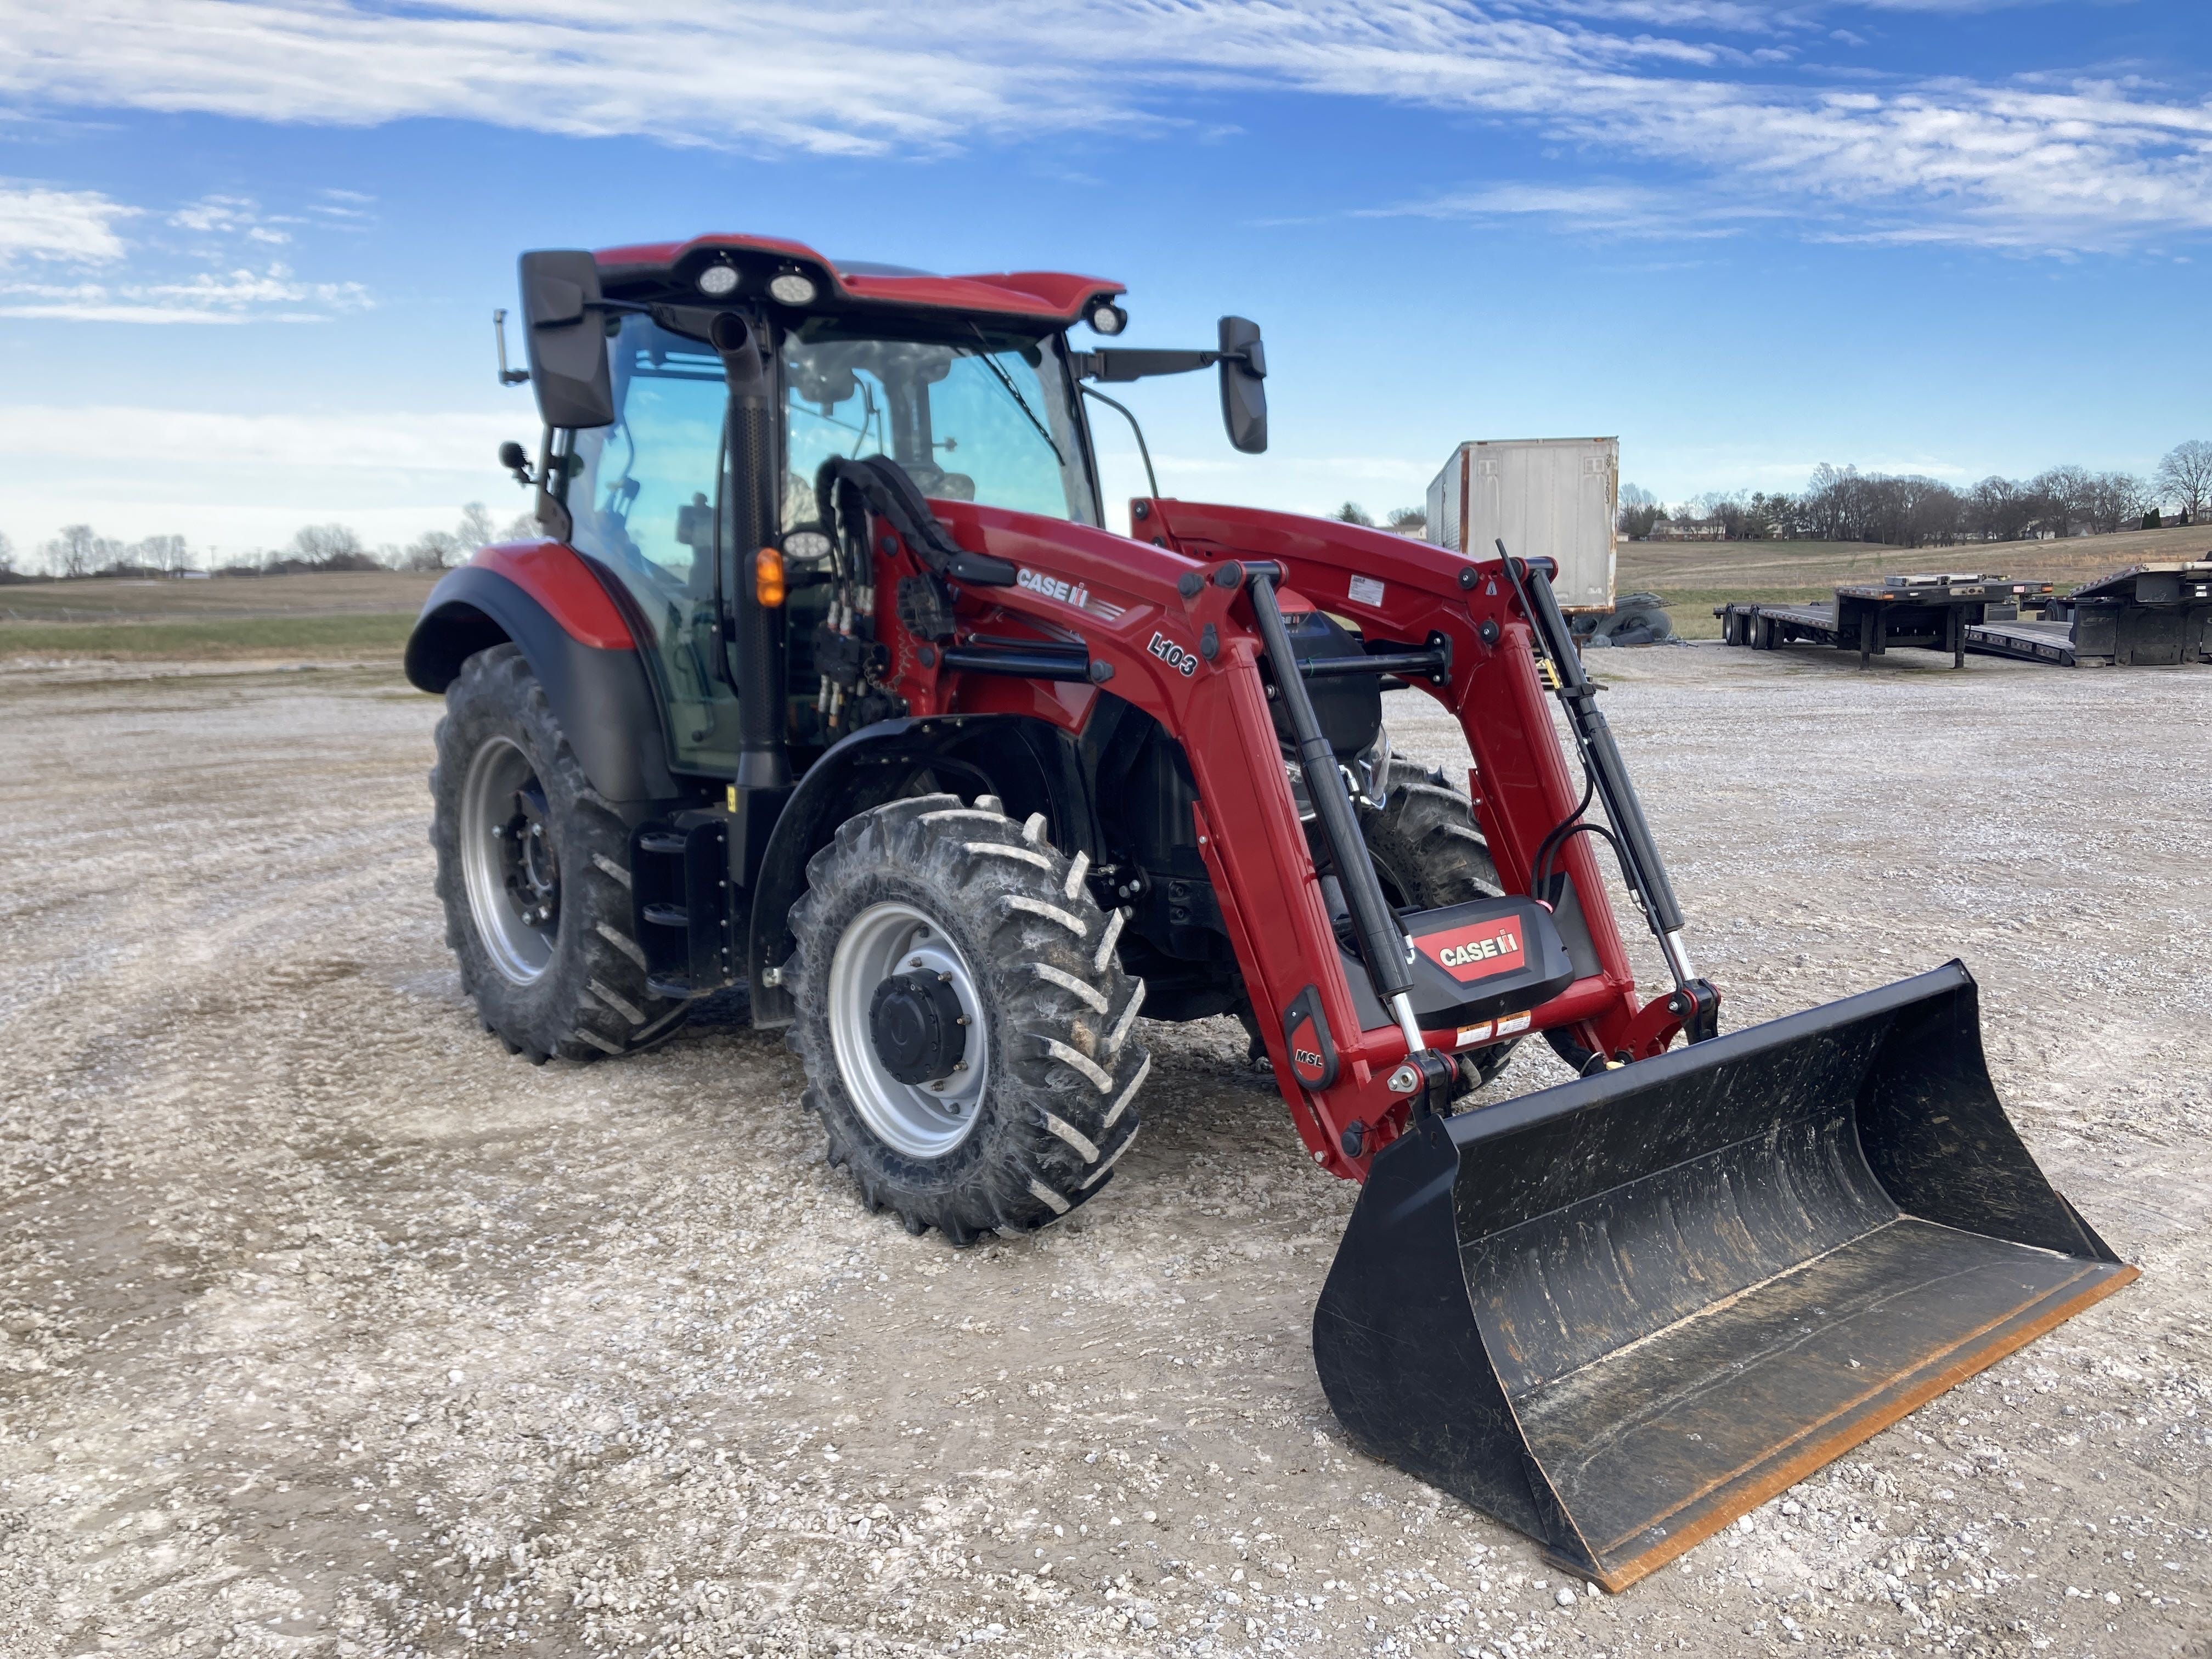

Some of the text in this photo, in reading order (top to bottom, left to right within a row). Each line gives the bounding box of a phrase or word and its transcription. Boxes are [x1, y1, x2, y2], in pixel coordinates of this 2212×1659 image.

[1017, 568, 1069, 601] CASE
[1147, 631, 1198, 677] L103
[1440, 938, 1498, 967] CASE
[1295, 1048, 1323, 1068] MSL
